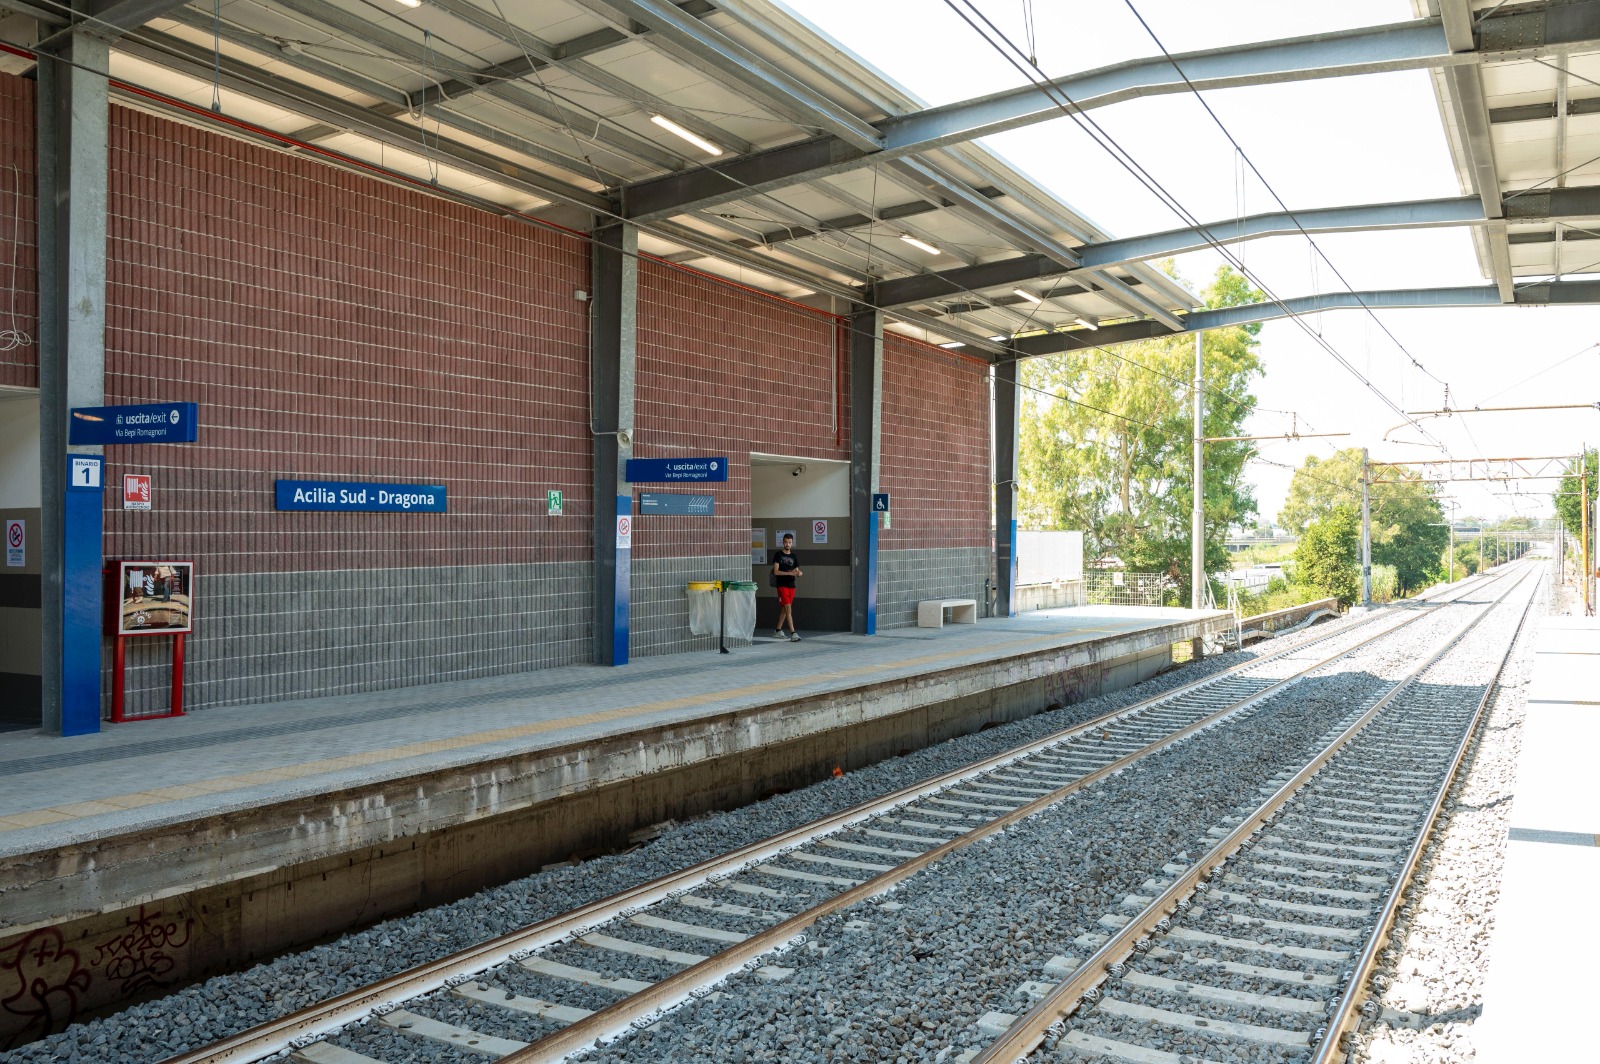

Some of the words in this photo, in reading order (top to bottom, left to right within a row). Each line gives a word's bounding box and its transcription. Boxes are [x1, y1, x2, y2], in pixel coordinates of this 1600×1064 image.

[126, 413, 166, 425] uscita/exit
[115, 429, 124, 437] Via
[124, 428, 136, 438] Bepi
[137, 427, 166, 438] Romagnoni
[673, 463, 708, 471] uscita/exit
[81, 467, 90, 484] 1
[294, 488, 336, 503] Acilia
[340, 489, 366, 504] Sud
[379, 490, 434, 508] Dragona
